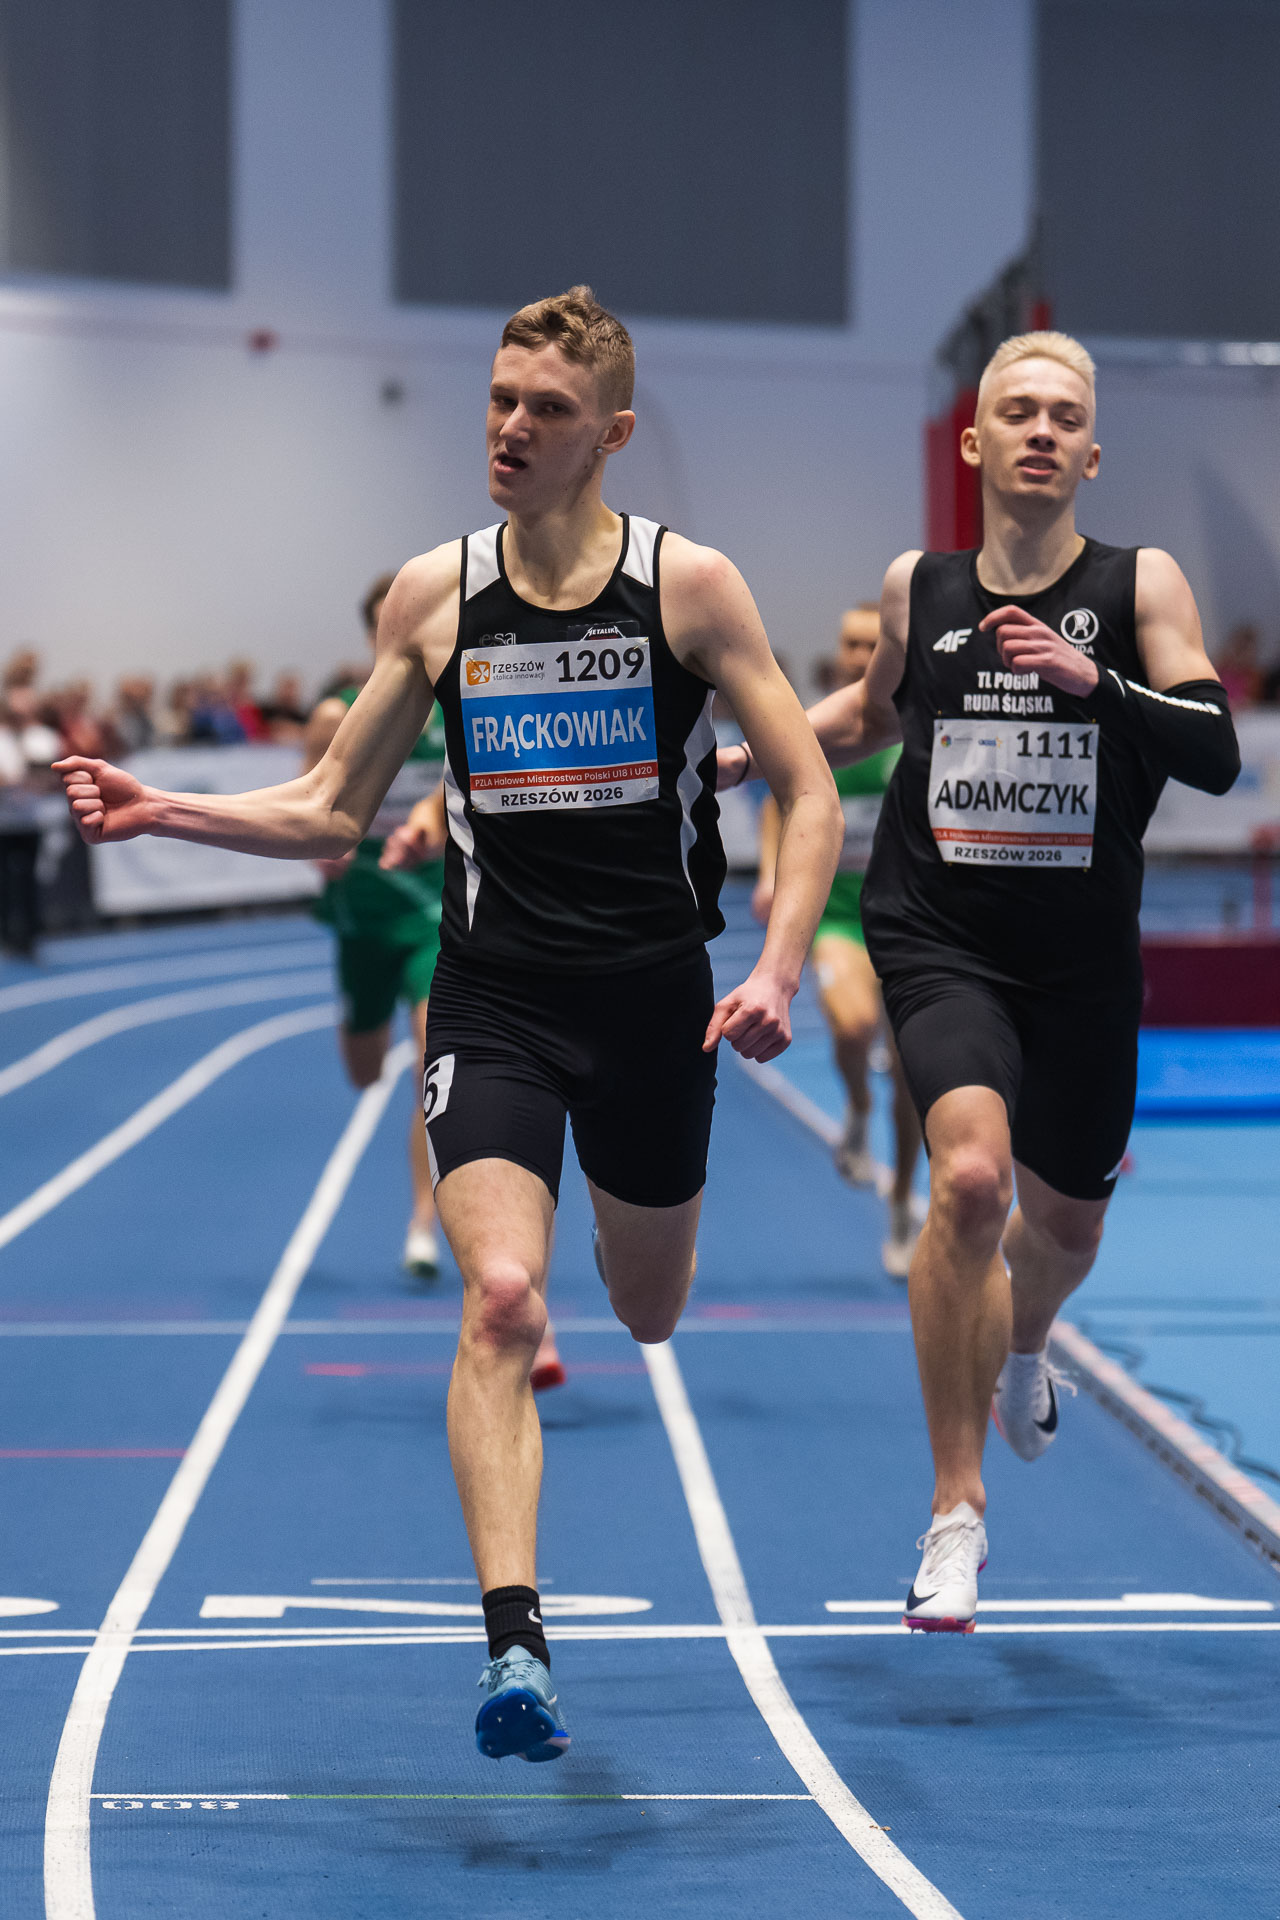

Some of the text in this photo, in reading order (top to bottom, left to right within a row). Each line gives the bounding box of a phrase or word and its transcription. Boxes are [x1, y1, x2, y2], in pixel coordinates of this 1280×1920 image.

[933, 628, 973, 653] 4F
[492, 660, 545, 674] rzeszów
[555, 648, 645, 682] 1209
[515, 672, 545, 681] innowacji
[977, 671, 992, 689] TL
[963, 692, 1054, 716] RUDA ŚLĄSKA
[471, 706, 647, 758] FRĄCKOWIAK
[1017, 730, 1093, 760] 1111
[475, 779, 493, 787] PZLA
[494, 777, 525, 786] Halowe
[527, 774, 583, 784] Mistrzostwa
[584, 771, 611, 781] Polski
[612, 769, 628, 778] U18
[634, 766, 653, 776] U20
[501, 786, 624, 807] RZESZÓW 2026
[934, 779, 1090, 816] ADAMCZYK
[954, 846, 1062, 862] RZESZÓW 2026
